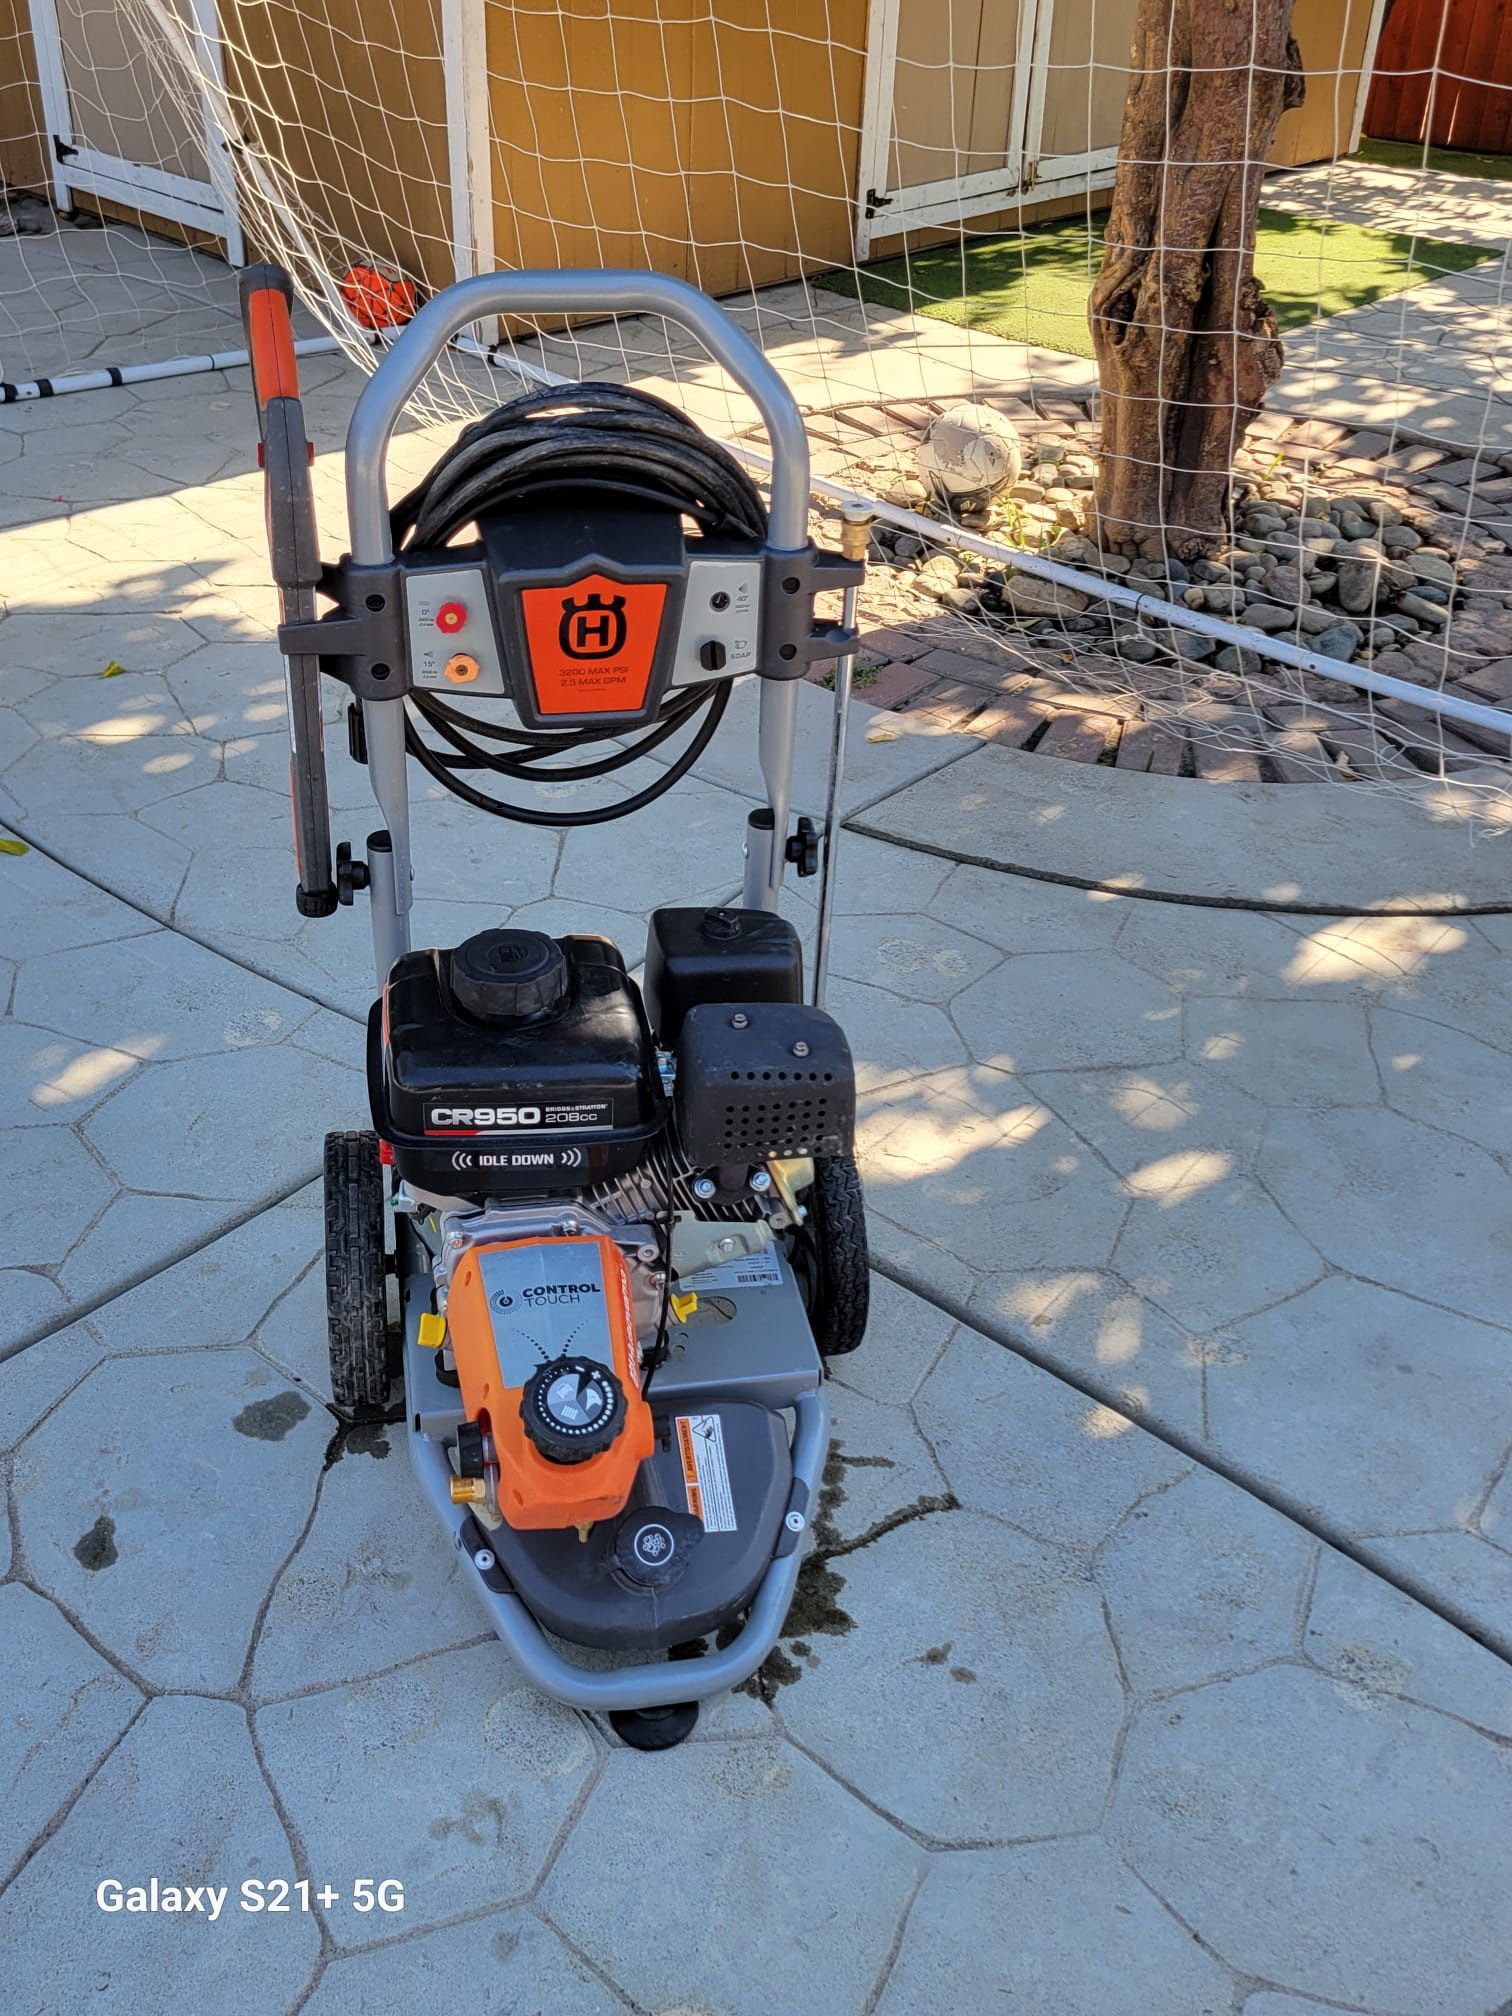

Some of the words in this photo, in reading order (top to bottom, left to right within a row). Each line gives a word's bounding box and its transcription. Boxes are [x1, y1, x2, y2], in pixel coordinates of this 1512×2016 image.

[730, 651, 751, 660] SOAP
[559, 668, 586, 677] 3200
[588, 667, 610, 675] MAX
[612, 666, 628, 674] PSI
[560, 679, 576, 687] 2.5
[578, 678, 601, 686] MAX
[603, 677, 625, 685] GPM
[431, 1107, 541, 1126] CR950
[545, 1112, 598, 1123] 208cc
[479, 1154, 509, 1166] IDLE
[511, 1153, 555, 1166] DOWN
[522, 1283, 601, 1298] CONTROL
[524, 1294, 581, 1307] TOUCH
